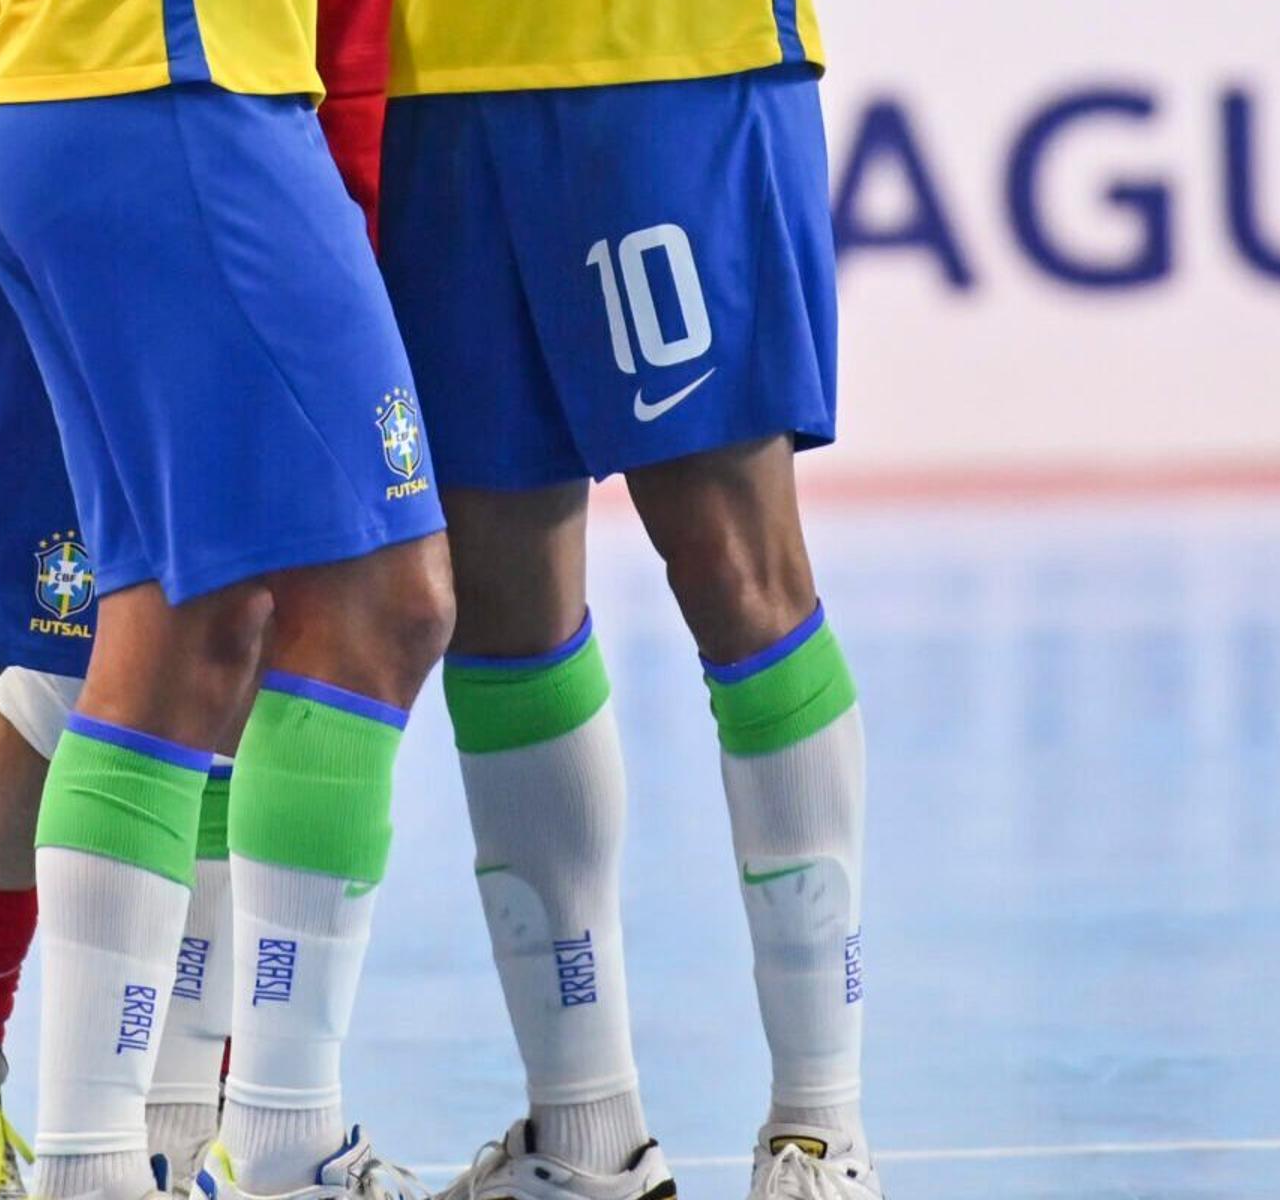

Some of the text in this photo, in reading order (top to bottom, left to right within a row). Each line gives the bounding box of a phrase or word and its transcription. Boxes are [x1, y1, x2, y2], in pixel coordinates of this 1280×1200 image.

[586, 223, 712, 374] 10
[386, 477, 428, 501] FUTSAL
[30, 618, 92, 638] FUTSAL
[253, 938, 296, 1006] BRASIL
[553, 929, 597, 1007] BRASIL
[116, 985, 156, 1054] BRASIL
